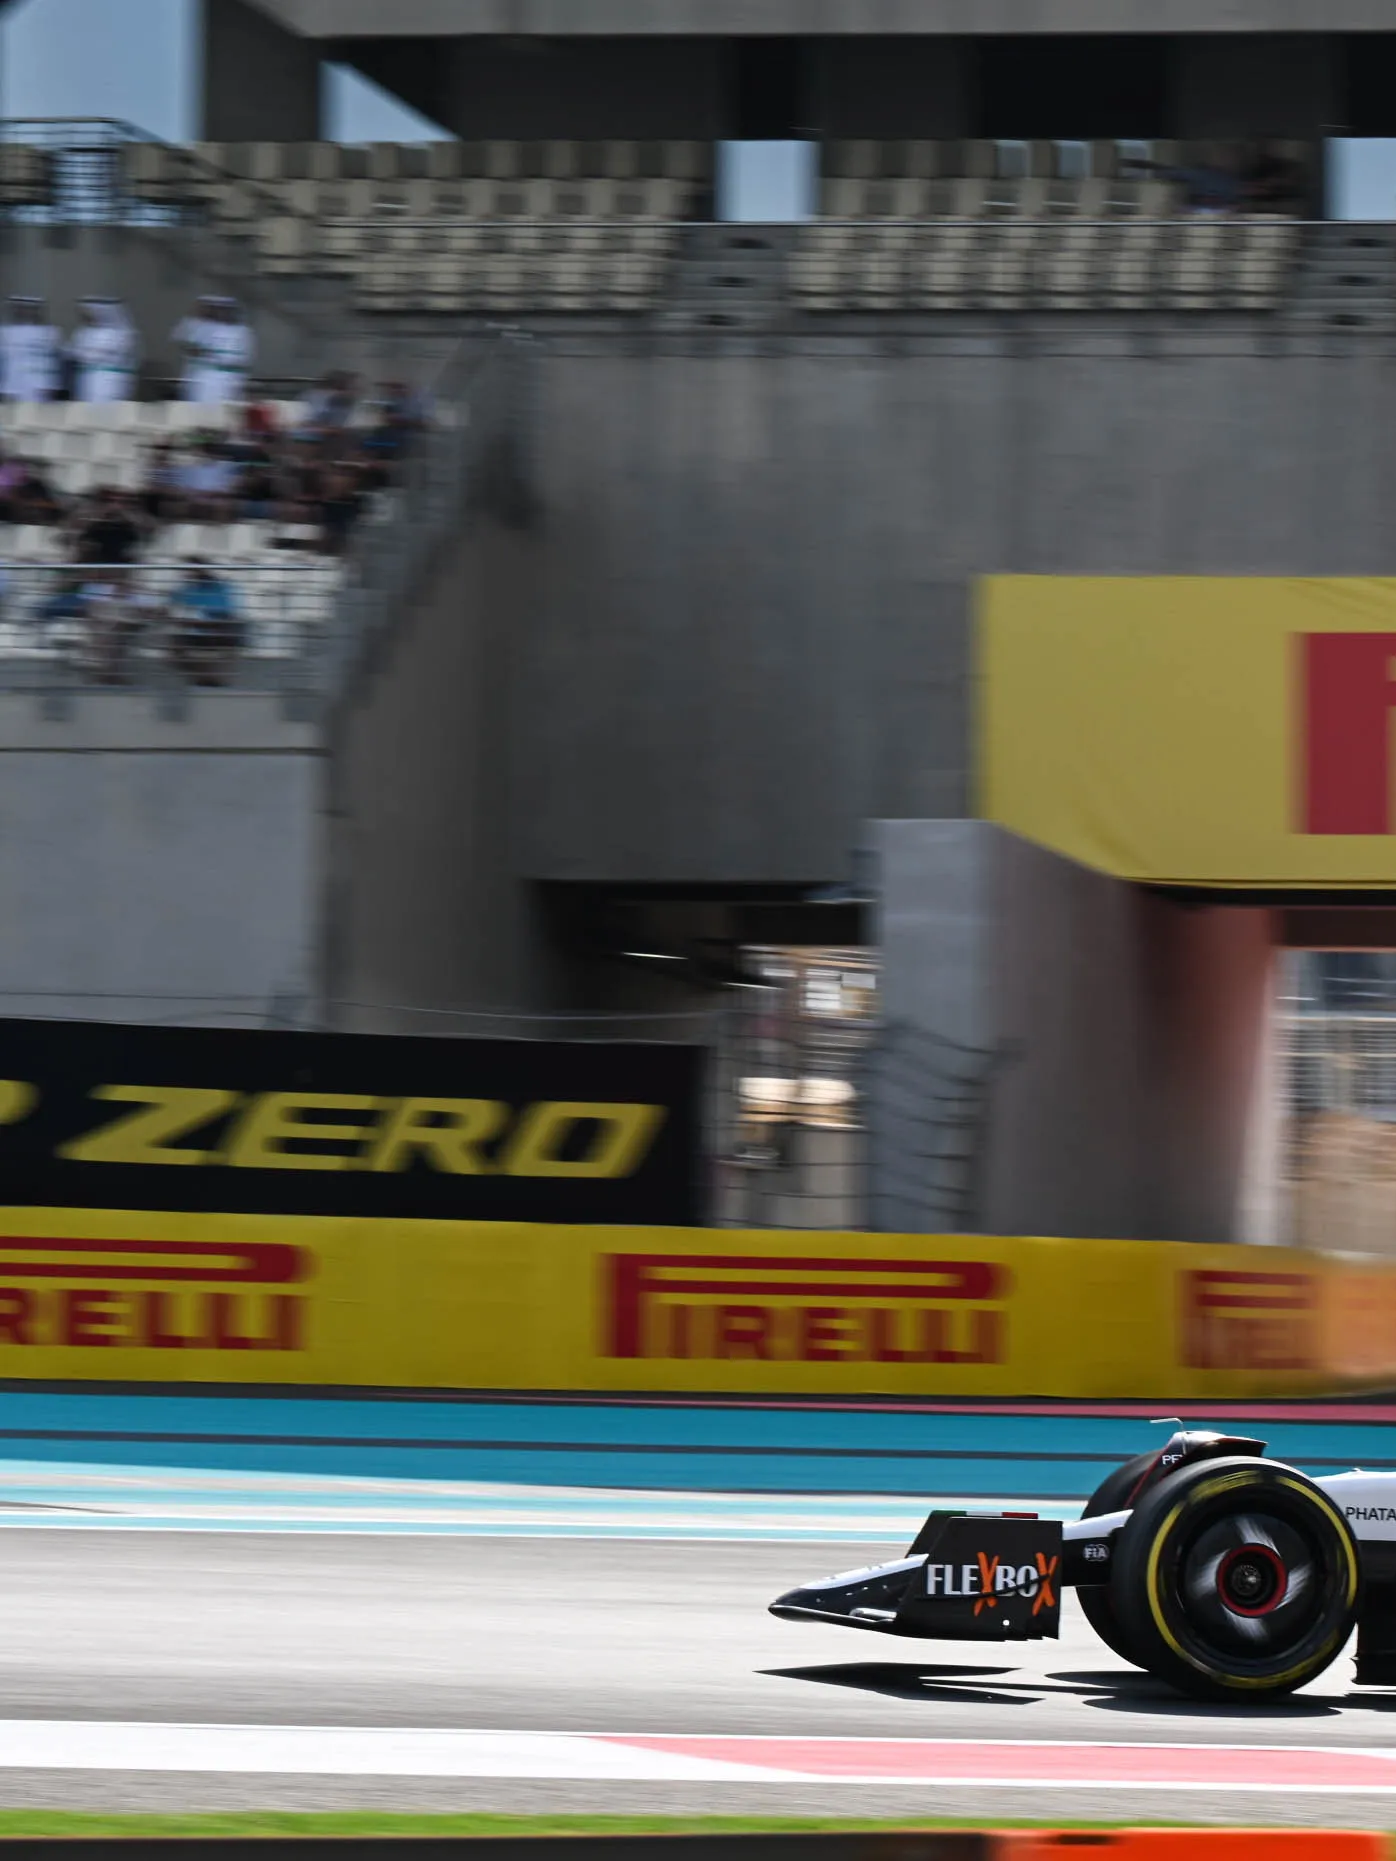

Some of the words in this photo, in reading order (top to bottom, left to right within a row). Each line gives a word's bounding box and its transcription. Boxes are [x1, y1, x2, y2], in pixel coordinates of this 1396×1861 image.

[58, 1083, 666, 1178] ZERO
[597, 1253, 1016, 1364] PIRELLI
[927, 1552, 1058, 1616] FLEXBOX
[1083, 1545, 1109, 1561] FIA
